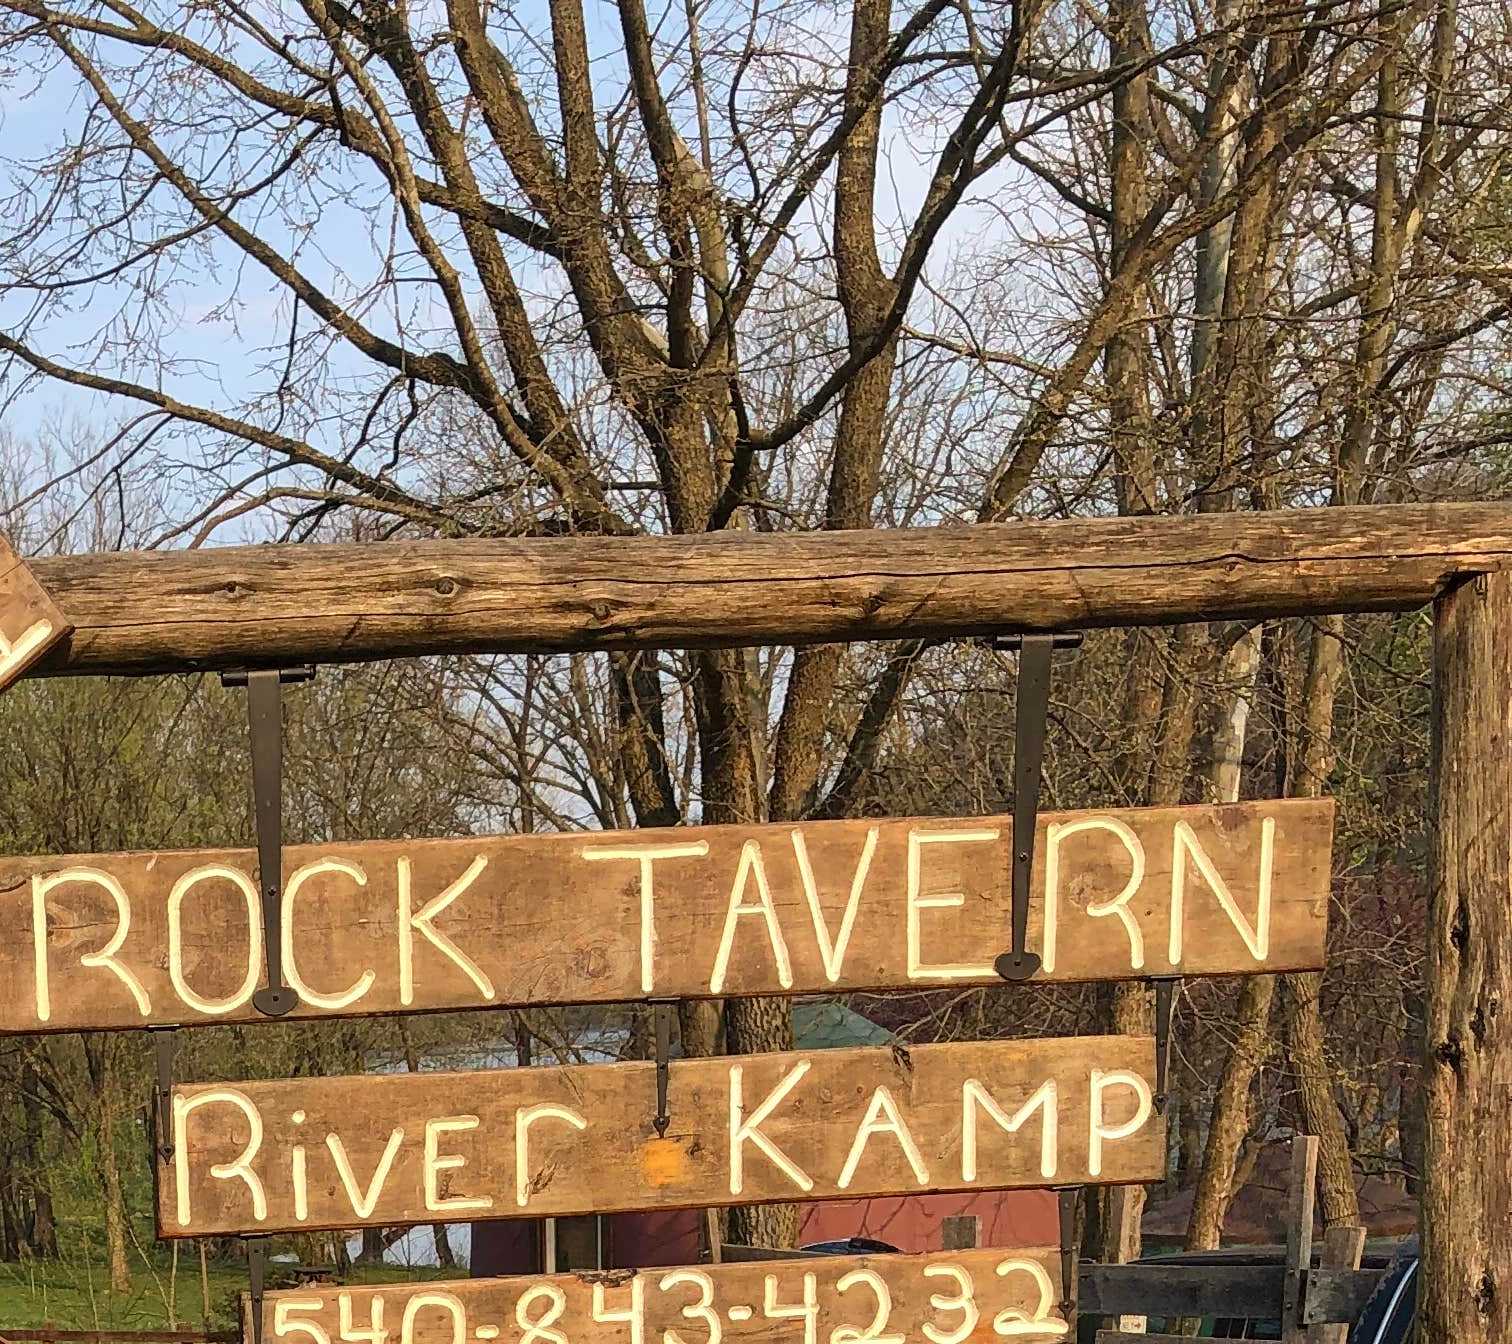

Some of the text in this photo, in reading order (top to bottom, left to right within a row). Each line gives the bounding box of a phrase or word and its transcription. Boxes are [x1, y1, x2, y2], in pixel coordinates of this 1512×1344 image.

[32, 816, 1276, 1021] ROCK TAVERN
[730, 1061, 1152, 1195] KAMP
